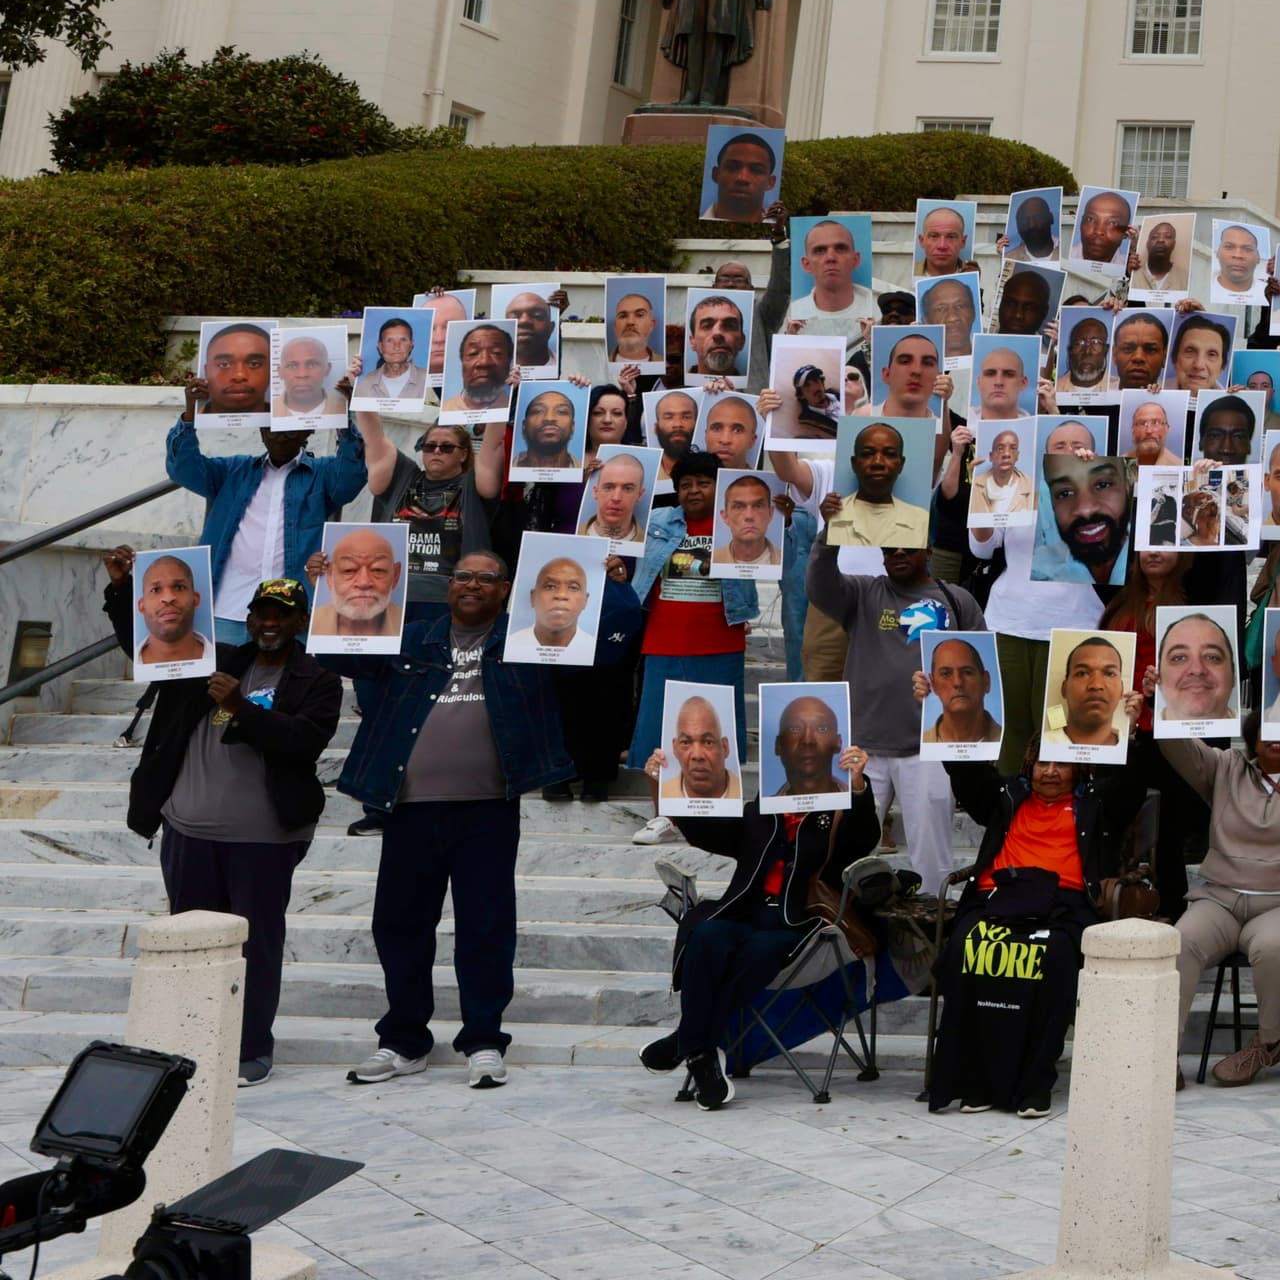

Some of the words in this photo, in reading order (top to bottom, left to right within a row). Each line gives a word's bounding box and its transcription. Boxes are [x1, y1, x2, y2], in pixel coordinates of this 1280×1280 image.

[409, 532, 441, 544] BAMA
[408, 544, 441, 555] UTION
[436, 693, 486, 703] Ridiculou
